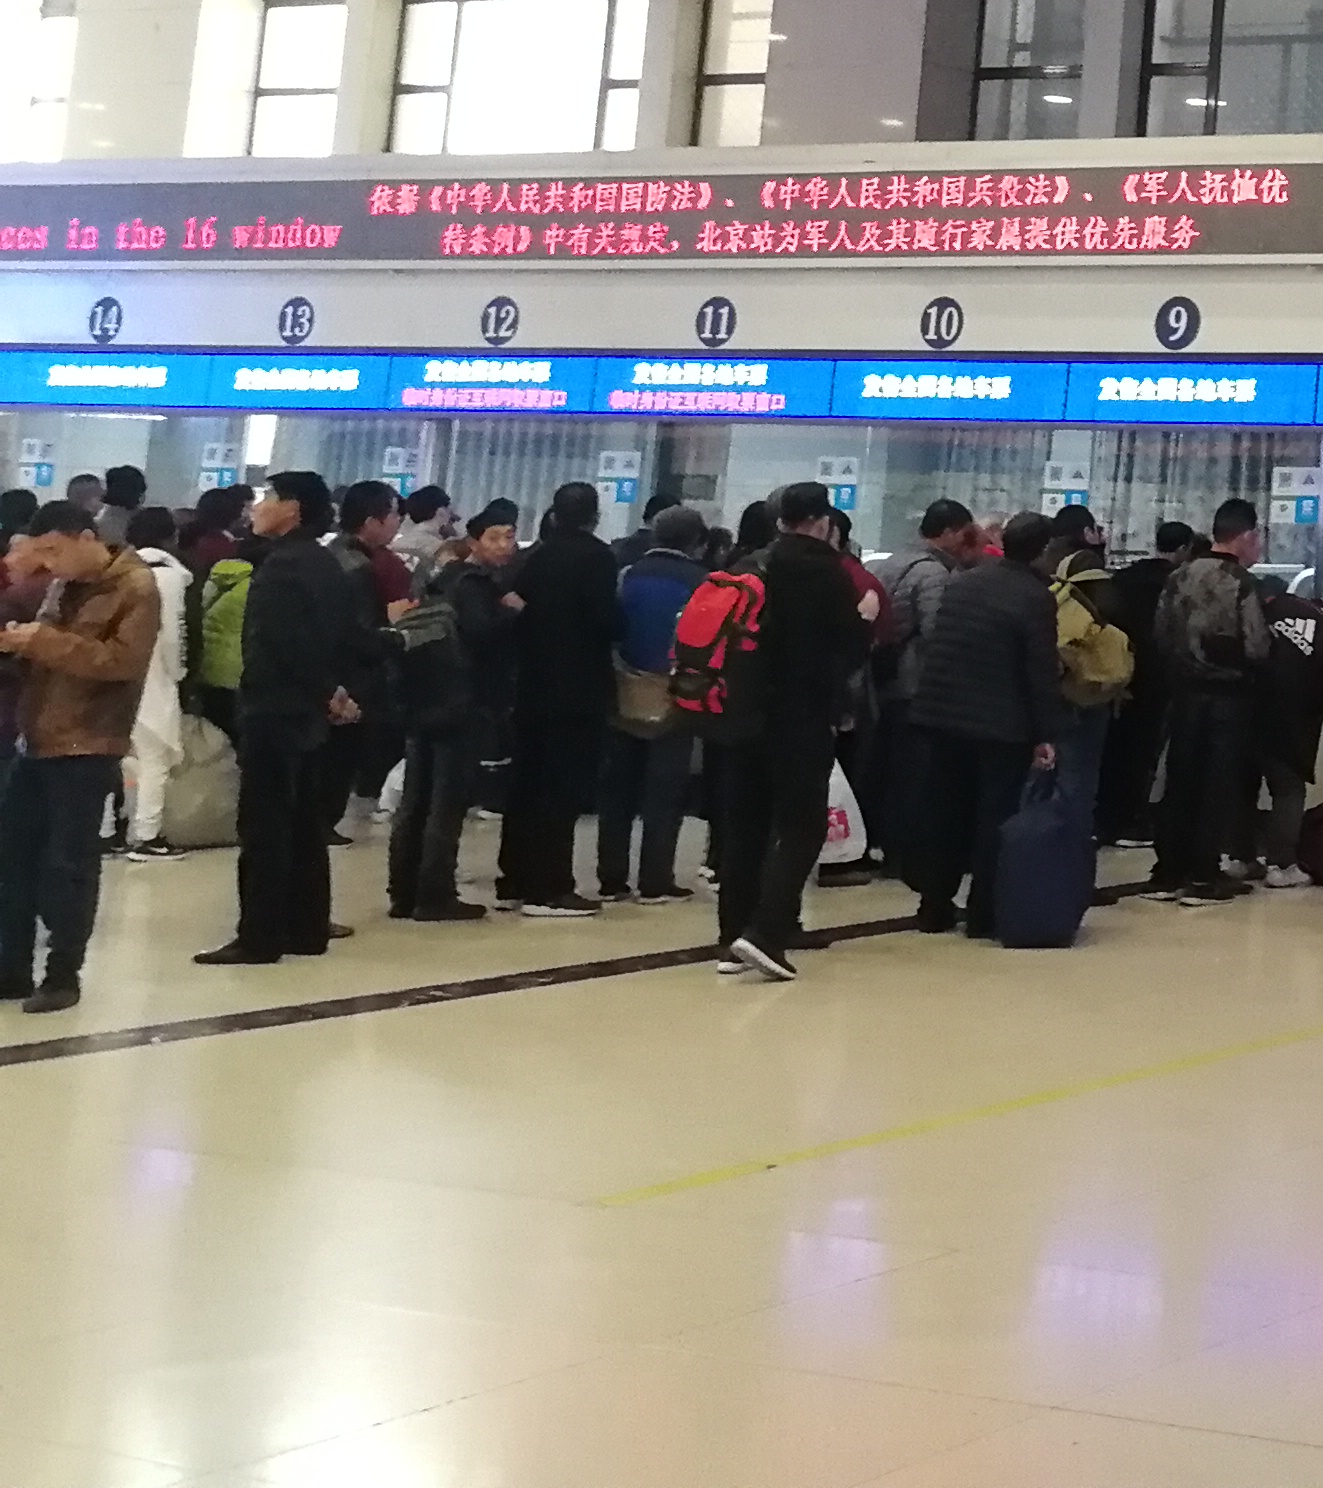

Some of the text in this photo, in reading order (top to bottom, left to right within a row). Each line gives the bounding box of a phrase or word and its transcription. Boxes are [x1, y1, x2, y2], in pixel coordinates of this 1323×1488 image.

[65, 217, 99, 251] in
[115, 217, 166, 251] the
[181, 216, 219, 250] 16
[231, 215, 343, 250] window
[90, 305, 121, 338] 14
[282, 305, 311, 337] 13
[487, 305, 517, 339] 12
[701, 306, 729, 339] 11
[925, 306, 958, 341] 10
[1168, 306, 1188, 342] 9
